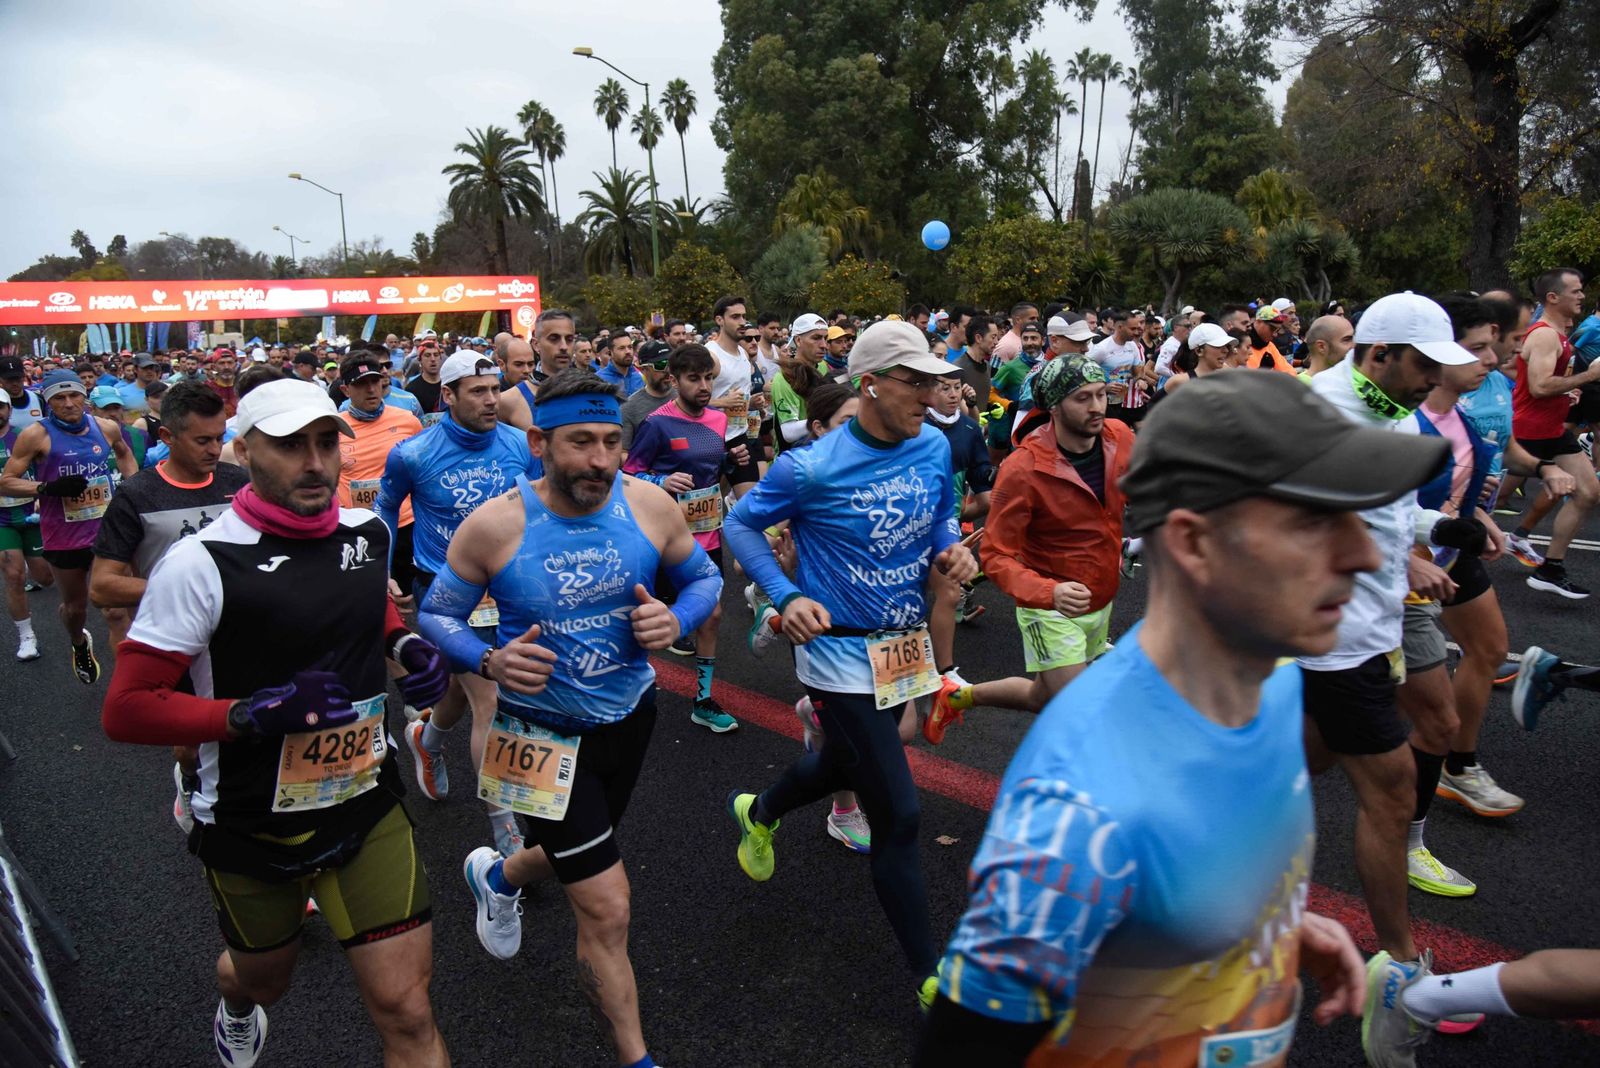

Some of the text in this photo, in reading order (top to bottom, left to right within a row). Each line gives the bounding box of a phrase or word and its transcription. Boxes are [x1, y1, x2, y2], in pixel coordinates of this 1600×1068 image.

[89, 295, 137, 310] HOKA
[452, 479, 483, 509] 25
[687, 498, 715, 516] 5407
[868, 496, 905, 539] 25
[557, 563, 594, 595] 25
[540, 613, 610, 636] Nutesca
[880, 638, 920, 670] 7168
[302, 726, 371, 765] 4282
[494, 735, 553, 773] 7167
